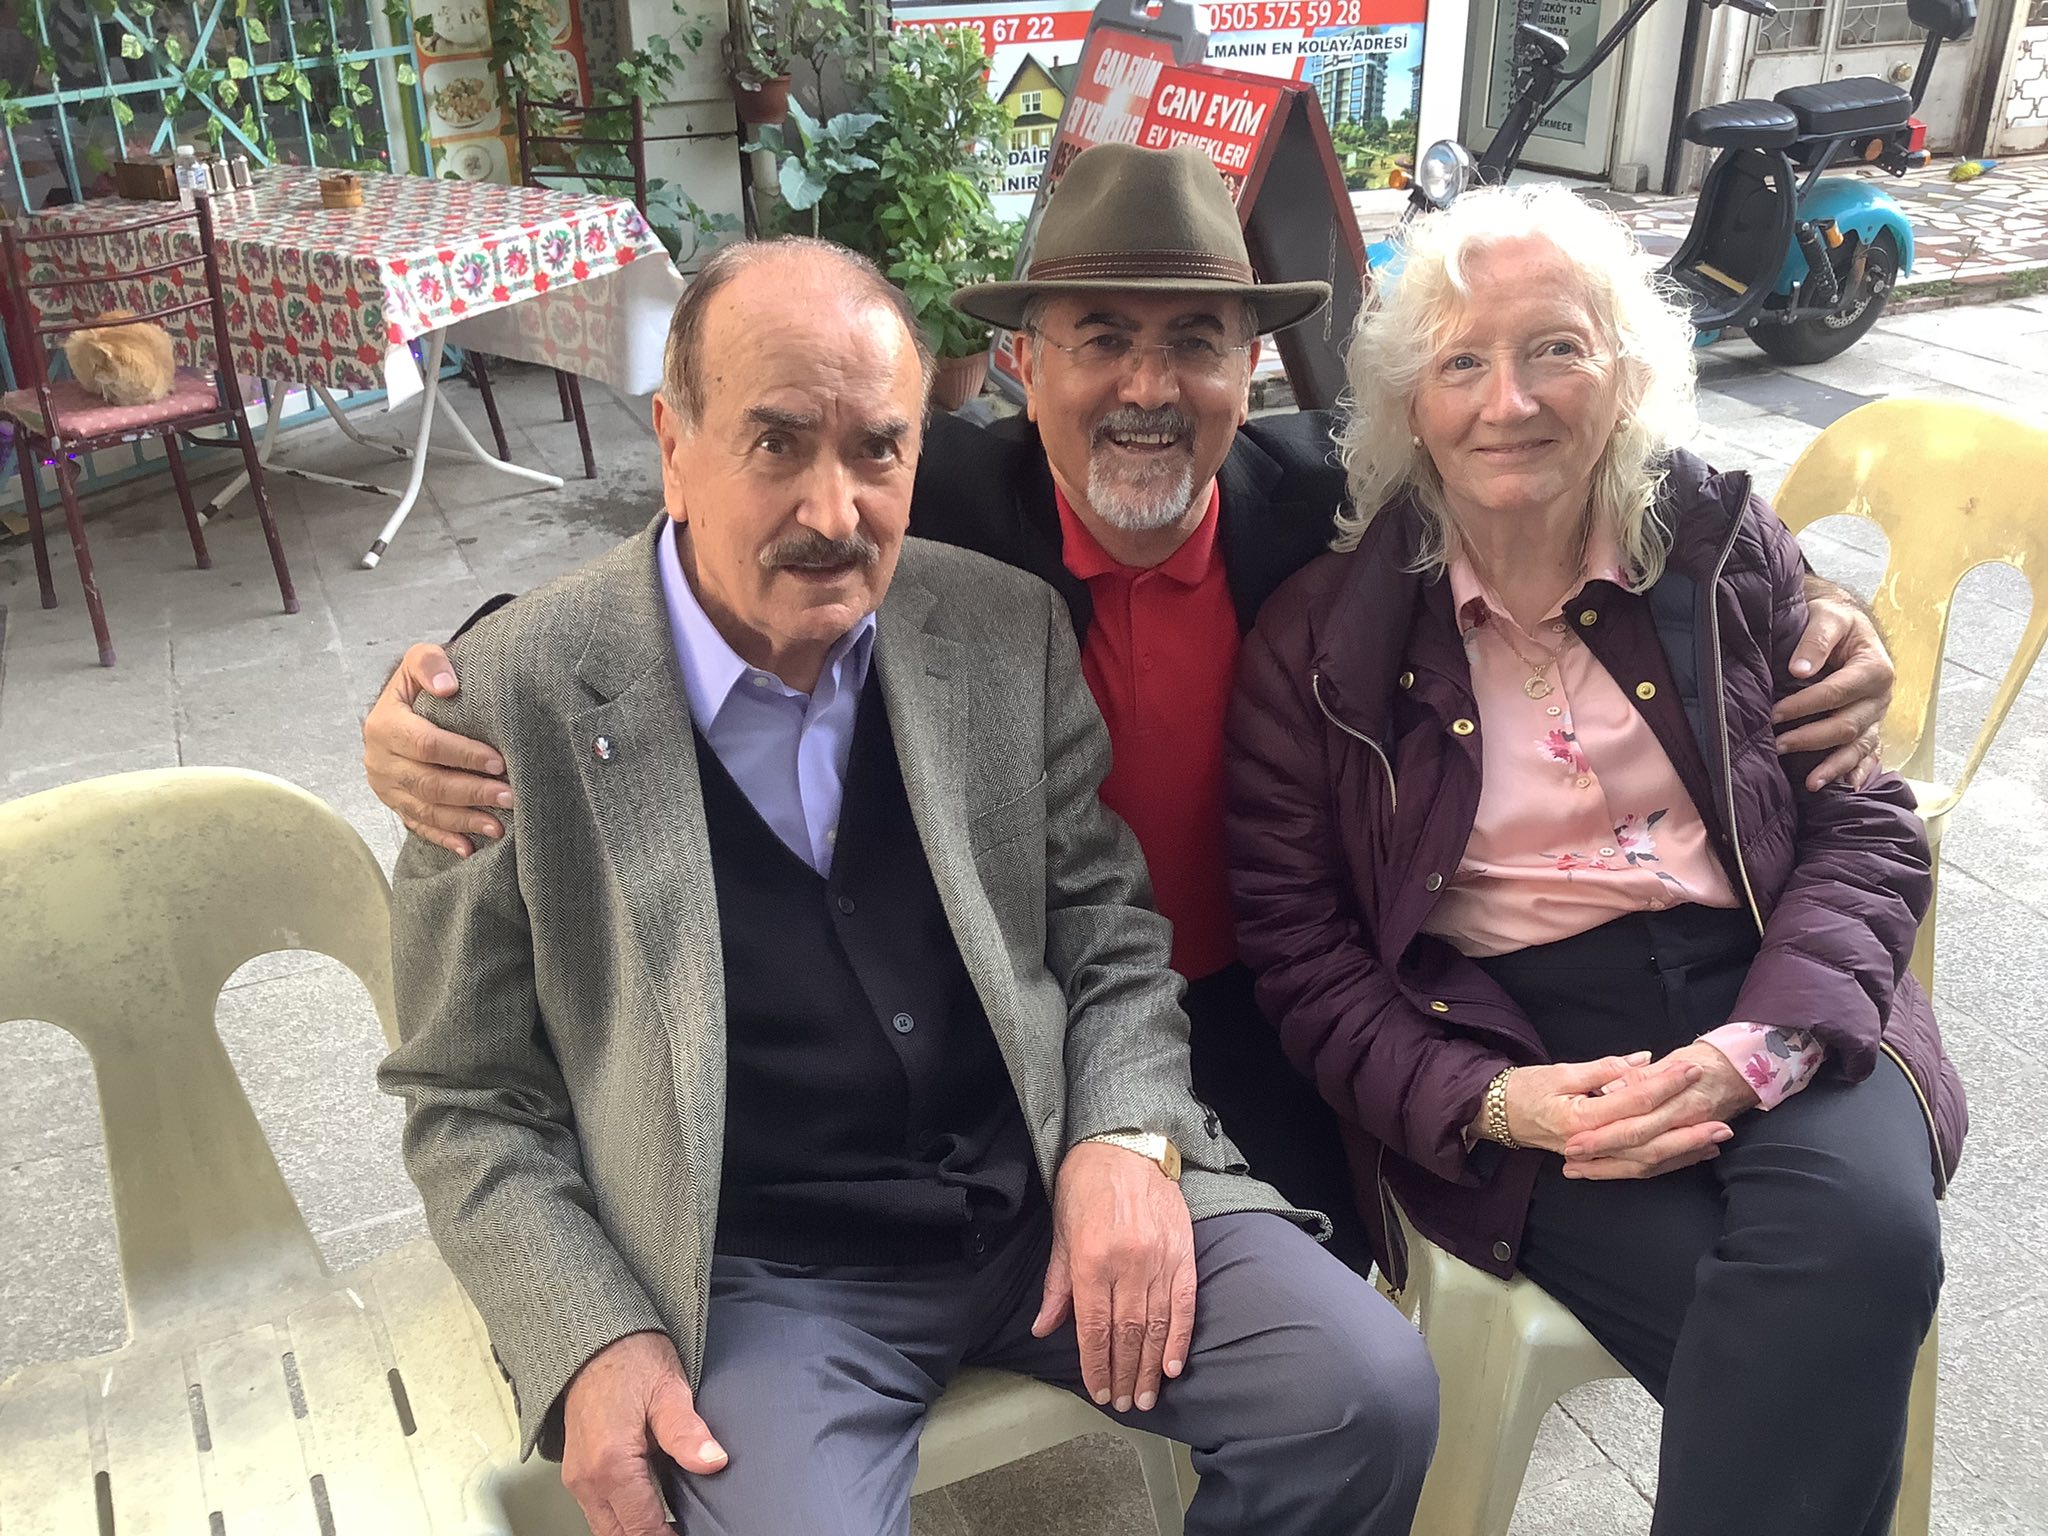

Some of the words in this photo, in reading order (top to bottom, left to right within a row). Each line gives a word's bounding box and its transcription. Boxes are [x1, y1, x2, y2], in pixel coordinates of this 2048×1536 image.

[992, 18, 1020, 42] 67
[1027, 16, 1055, 40] 22
[1209, 3, 1258, 31] 0505
[1263, 2, 1300, 28] 575
[1306, 1, 1332, 27] 59
[1336, 0, 1361, 25] 28
[1272, 41, 1293, 56] EN
[1353, 33, 1408, 52] ADRESİ
[1093, 47, 1131, 90] CAN
[1157, 84, 1207, 123] CAN
[1203, 89, 1267, 137] EVİM
[1146, 124, 1169, 147] EV
